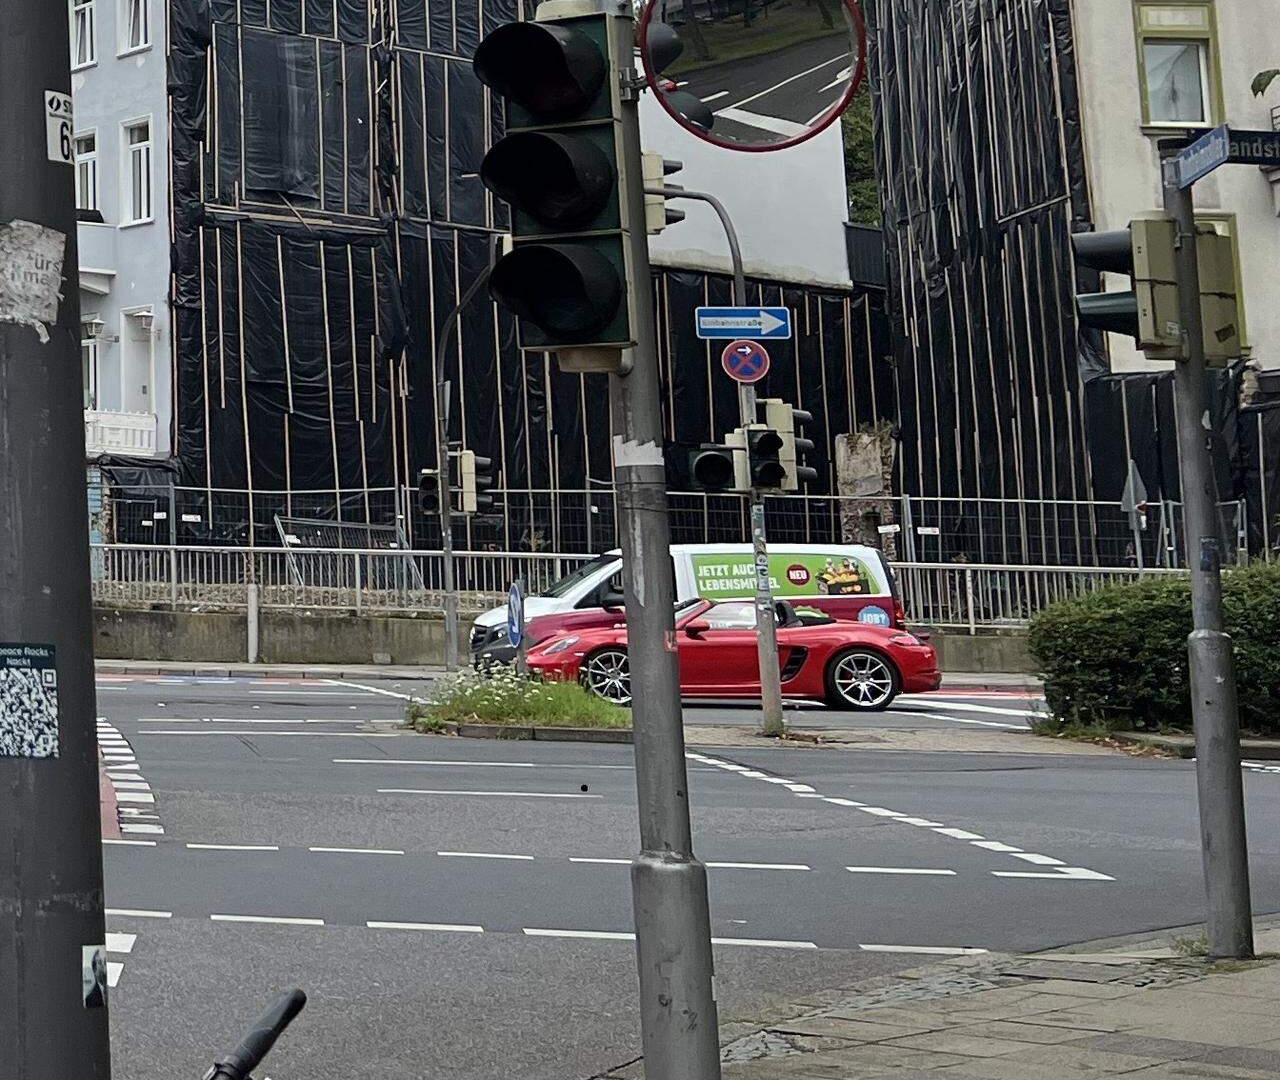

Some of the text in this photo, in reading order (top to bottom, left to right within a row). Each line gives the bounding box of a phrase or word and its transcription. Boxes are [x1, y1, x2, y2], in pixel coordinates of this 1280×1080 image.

[60, 121, 75, 162] 6
[1230, 138, 1280, 157] andst
[698, 563, 756, 577] JETZT AUC
[788, 570, 808, 580] NEU
[699, 576, 781, 591] LEBENSMITEL
